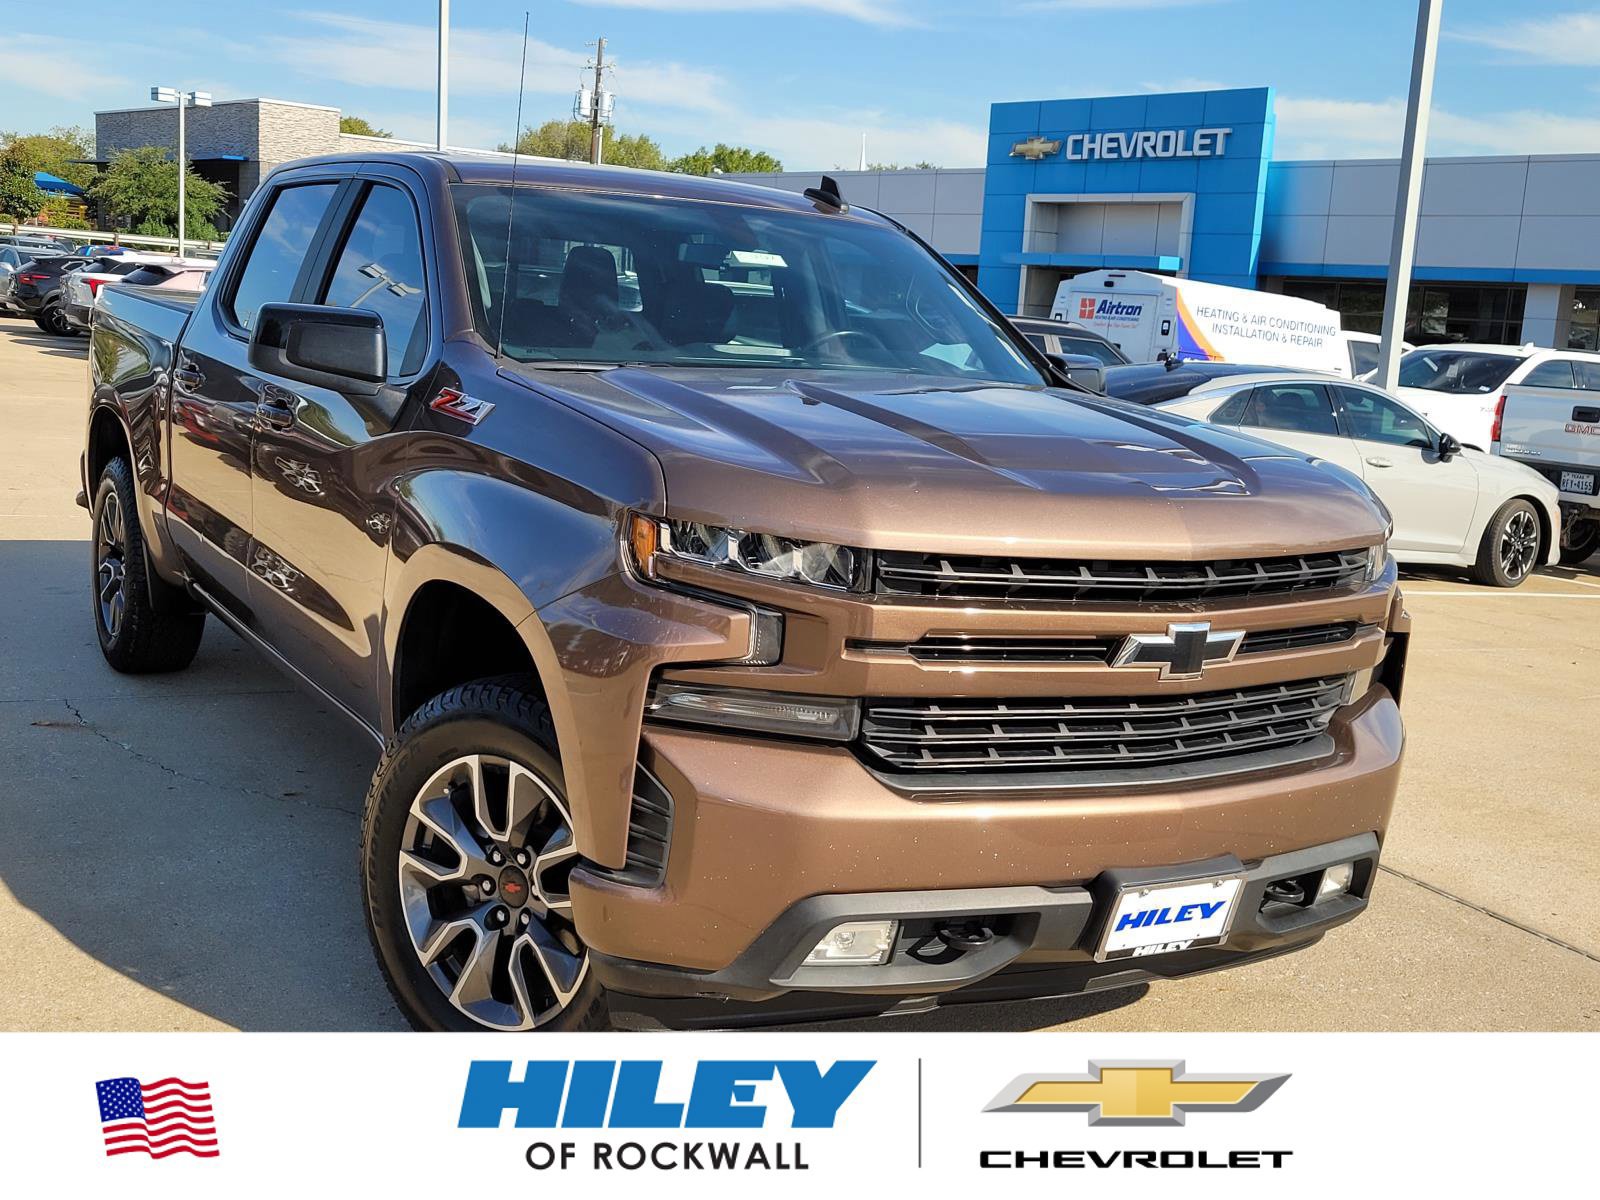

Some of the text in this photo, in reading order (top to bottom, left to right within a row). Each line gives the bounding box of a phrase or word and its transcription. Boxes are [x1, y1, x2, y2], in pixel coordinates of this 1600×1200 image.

[1066, 128, 1232, 160] CHEVROLET
[1096, 299, 1142, 316] Airtron
[1196, 306, 1336, 337] HEATING & AIR CONDITIONING
[1212, 323, 1323, 348] INSTALLATION & REPAIR
[1115, 901, 1226, 932] HILEY
[1132, 940, 1194, 957] HILEY
